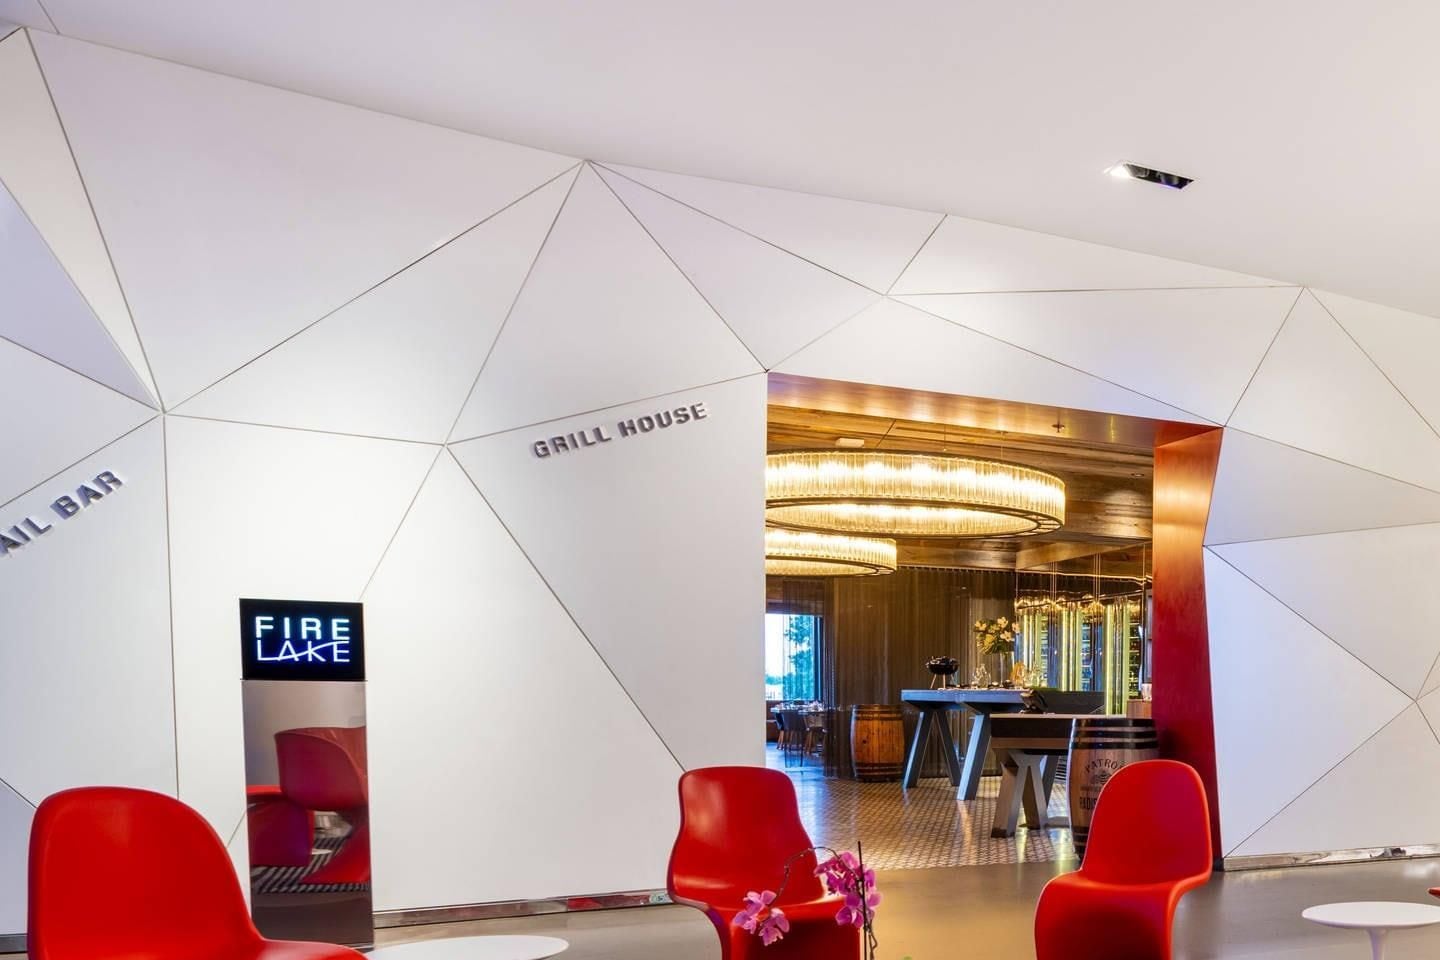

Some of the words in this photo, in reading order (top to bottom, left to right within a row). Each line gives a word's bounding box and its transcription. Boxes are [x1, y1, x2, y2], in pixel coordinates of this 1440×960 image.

[532, 427, 611, 458] GRILL
[617, 402, 707, 438] HOUSE
[49, 470, 123, 520] BAR
[255, 616, 350, 640] FIRE
[257, 640, 350, 662] LAKE
[1085, 758, 1124, 774] PATRO
